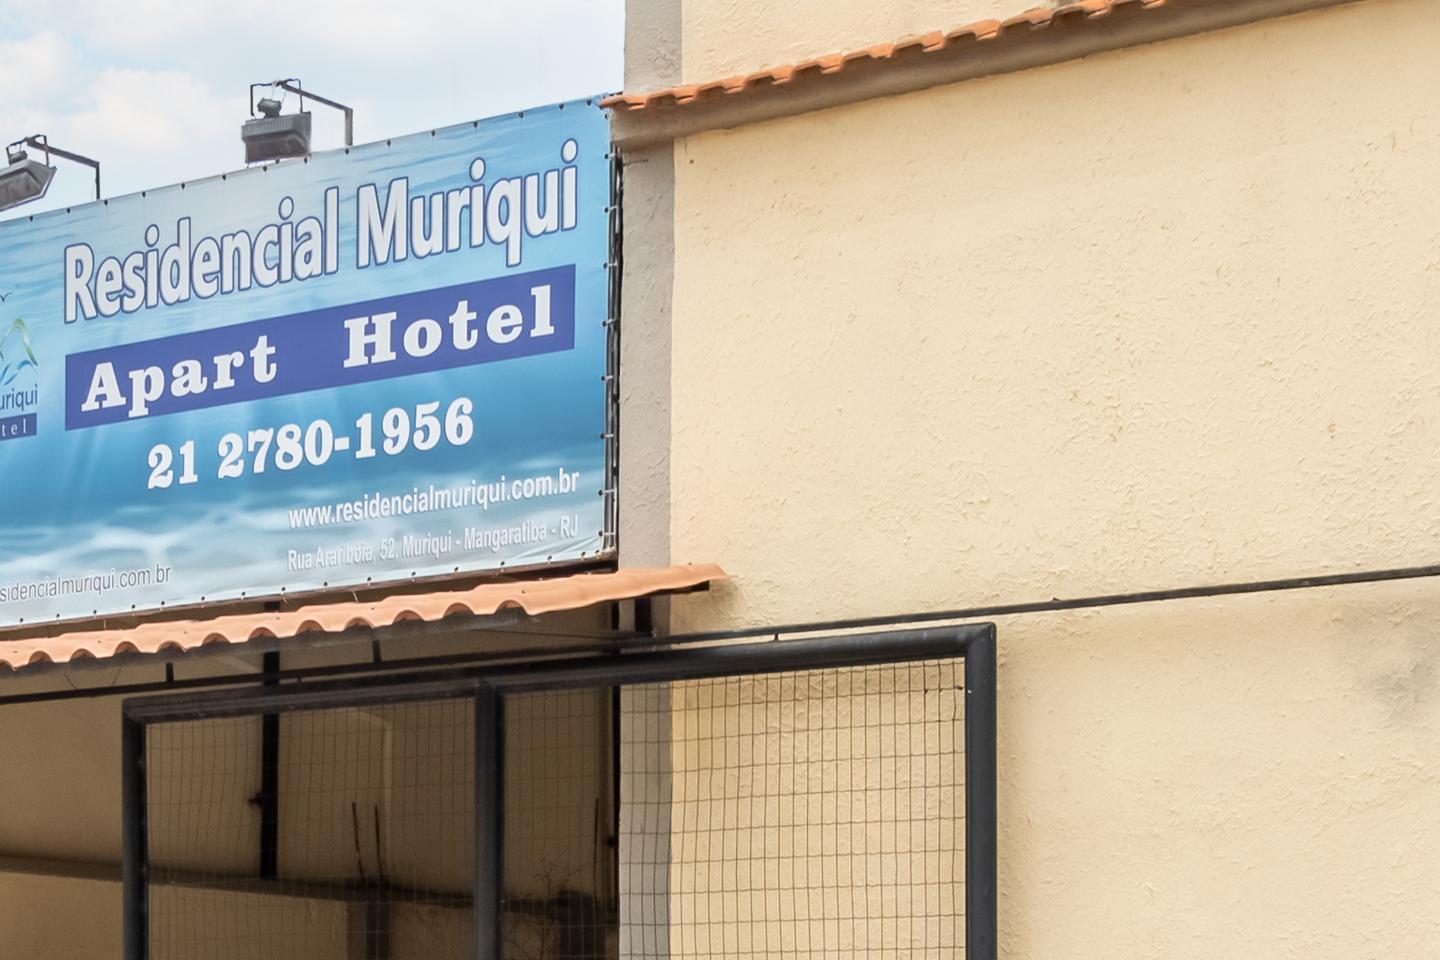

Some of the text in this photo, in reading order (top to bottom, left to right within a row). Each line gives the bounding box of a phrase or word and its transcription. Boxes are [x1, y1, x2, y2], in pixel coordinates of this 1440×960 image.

[64, 138, 578, 324] Residencial Muriqui
[81, 284, 555, 417] Apart Hotel
[147, 397, 474, 489] 21 2780-1956
[288, 468, 579, 529] www.residencialmuriqui.com.br
[288, 549, 312, 572] Rua
[379, 537, 399, 561] 52,
[403, 531, 452, 559] Muriqui
[464, 519, 547, 552] Mangaratiba
[560, 514, 579, 539] RJ
